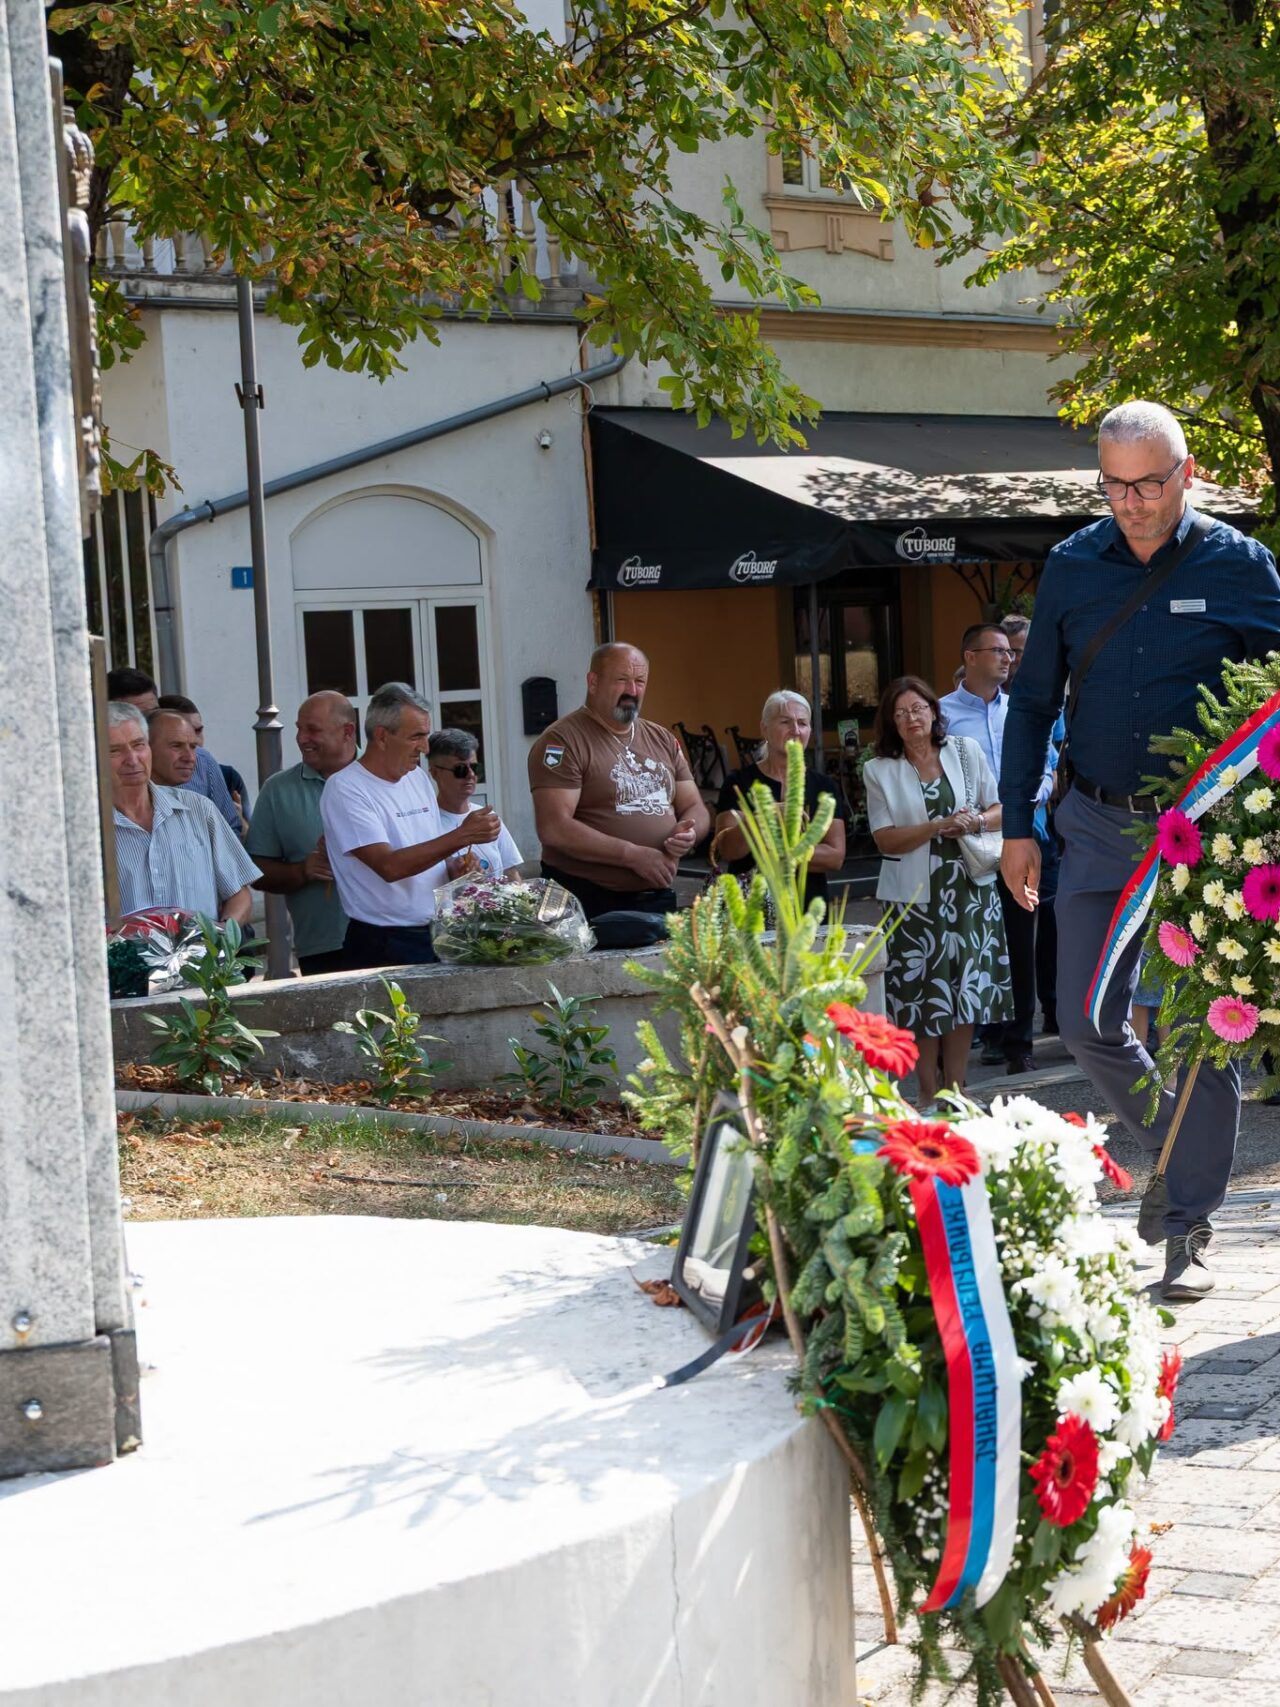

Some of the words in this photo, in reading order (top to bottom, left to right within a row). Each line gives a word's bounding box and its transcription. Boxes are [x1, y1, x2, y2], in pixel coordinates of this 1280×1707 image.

[904, 537, 956, 553] TUBORG
[625, 565, 662, 580] TUBORG
[736, 560, 778, 575] TUBORG
[640, 798, 665, 816] 35
[941, 1194, 983, 1322] РЕПУБЛИКЕ
[972, 1339, 998, 1464] ЈУНАЦИМА
